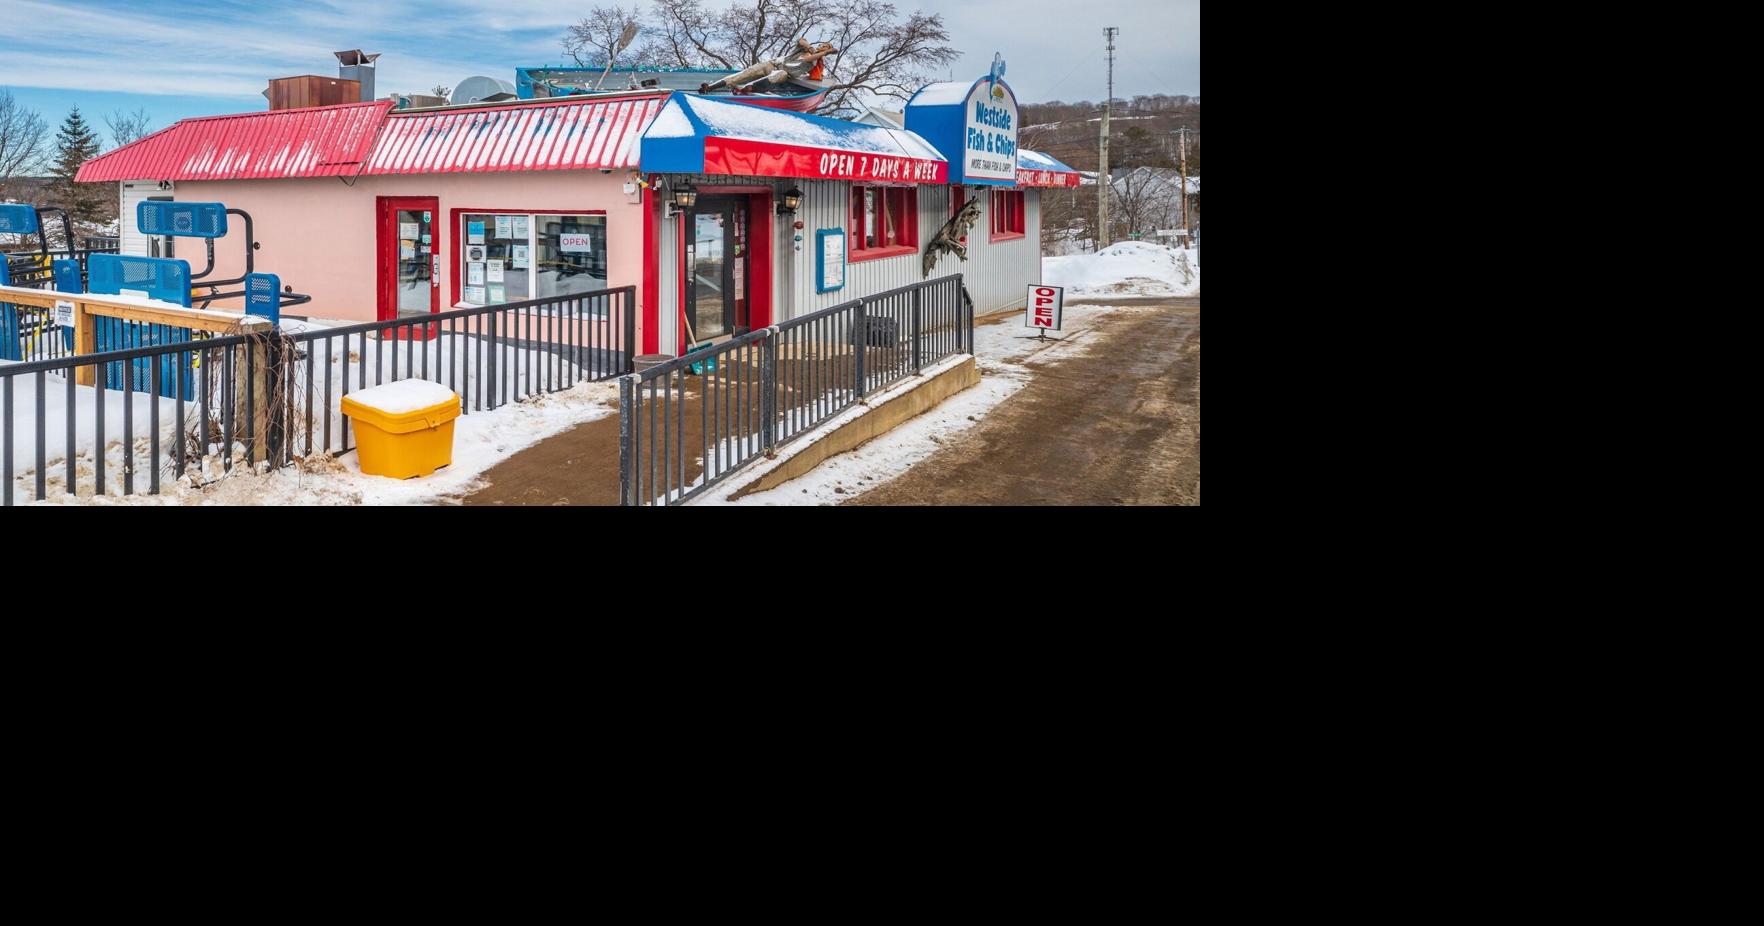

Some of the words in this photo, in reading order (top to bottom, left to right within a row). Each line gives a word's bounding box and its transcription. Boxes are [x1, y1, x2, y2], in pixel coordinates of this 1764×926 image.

[976, 101, 1011, 130] Westside
[968, 127, 984, 151] Fish
[987, 132, 993, 152] &
[996, 134, 1015, 159] Chips
[820, 153, 854, 176] OPEN
[860, 157, 867, 176] 7
[872, 158, 899, 178] DAYS
[903, 161, 910, 179] A
[914, 162, 938, 180] WEEK
[971, 159, 981, 169] MORE
[562, 238, 588, 246] OPEN
[1034, 287, 1055, 327] OPEN
